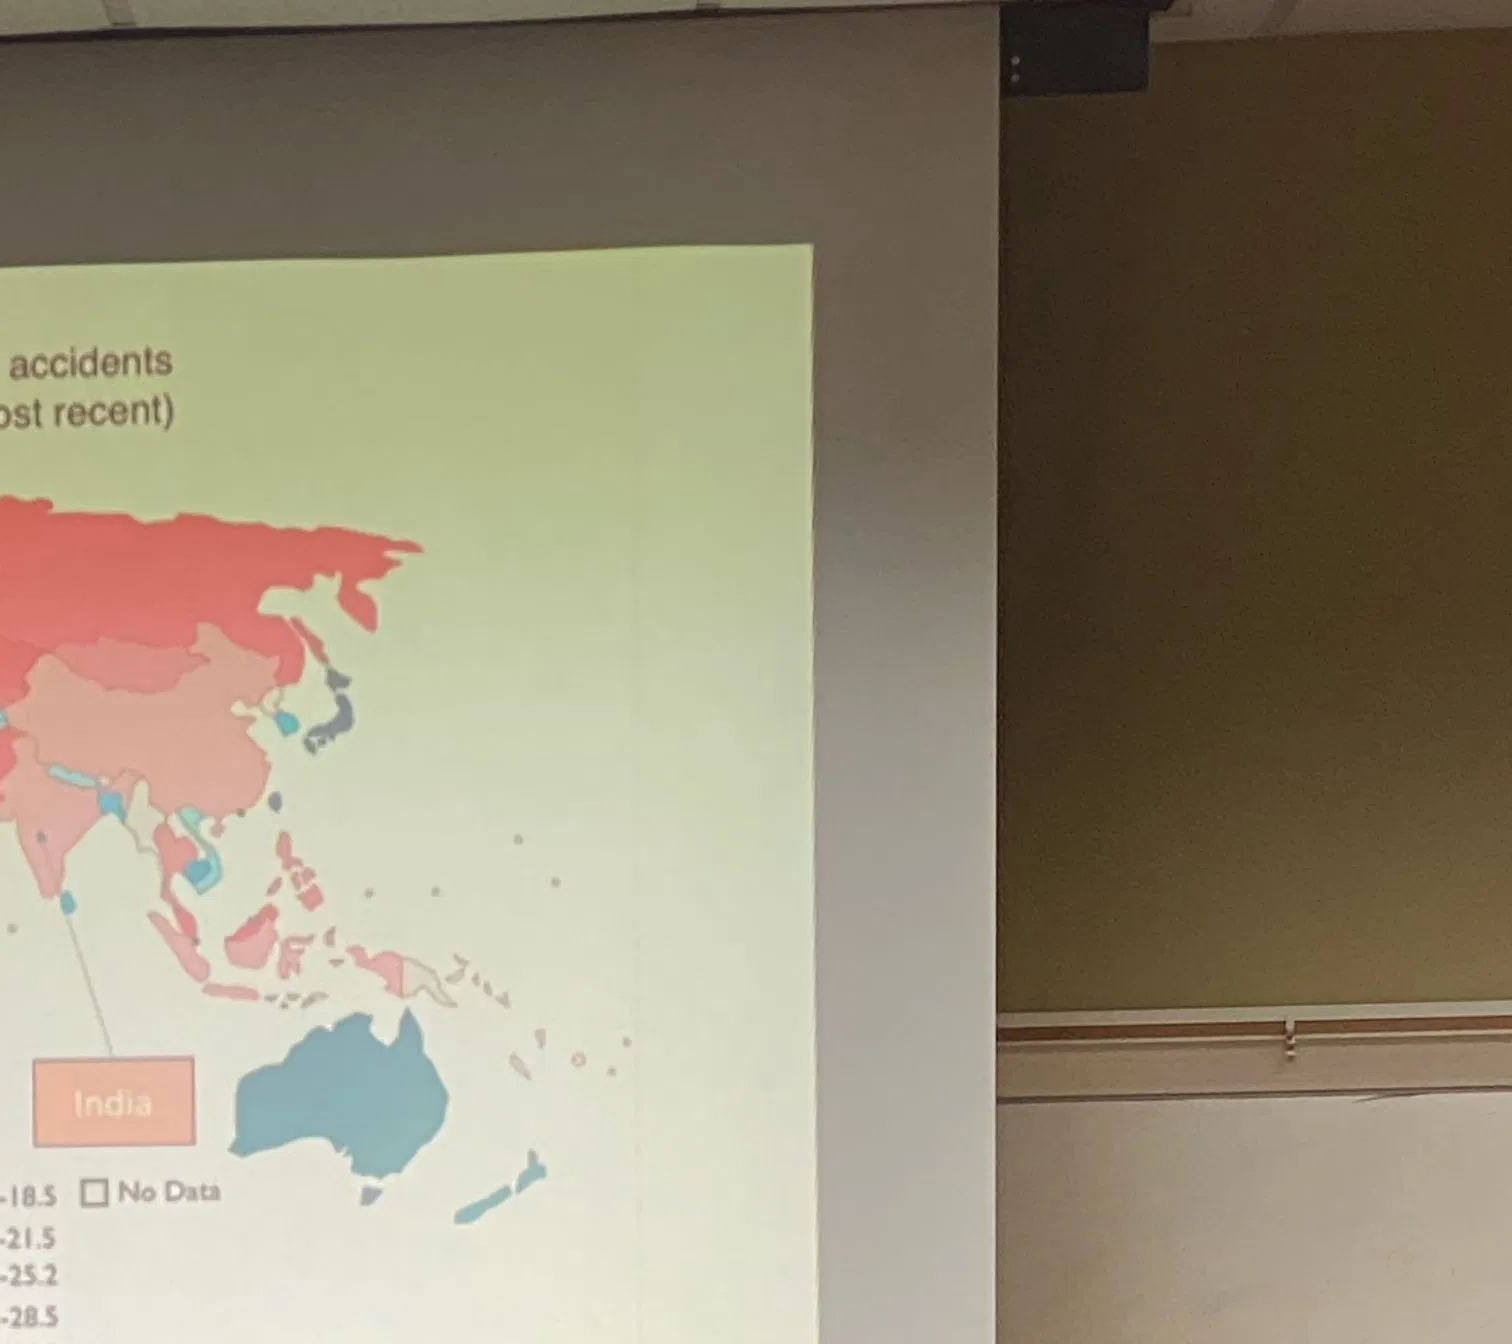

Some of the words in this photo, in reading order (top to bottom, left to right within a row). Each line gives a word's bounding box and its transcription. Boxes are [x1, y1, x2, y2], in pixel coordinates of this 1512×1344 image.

[9, 345, 175, 381] accidents
[54, 391, 175, 432] recent)
[73, 1087, 154, 1118] India
[118, 1182, 157, 1203] No
[165, 1181, 221, 1203] Data
